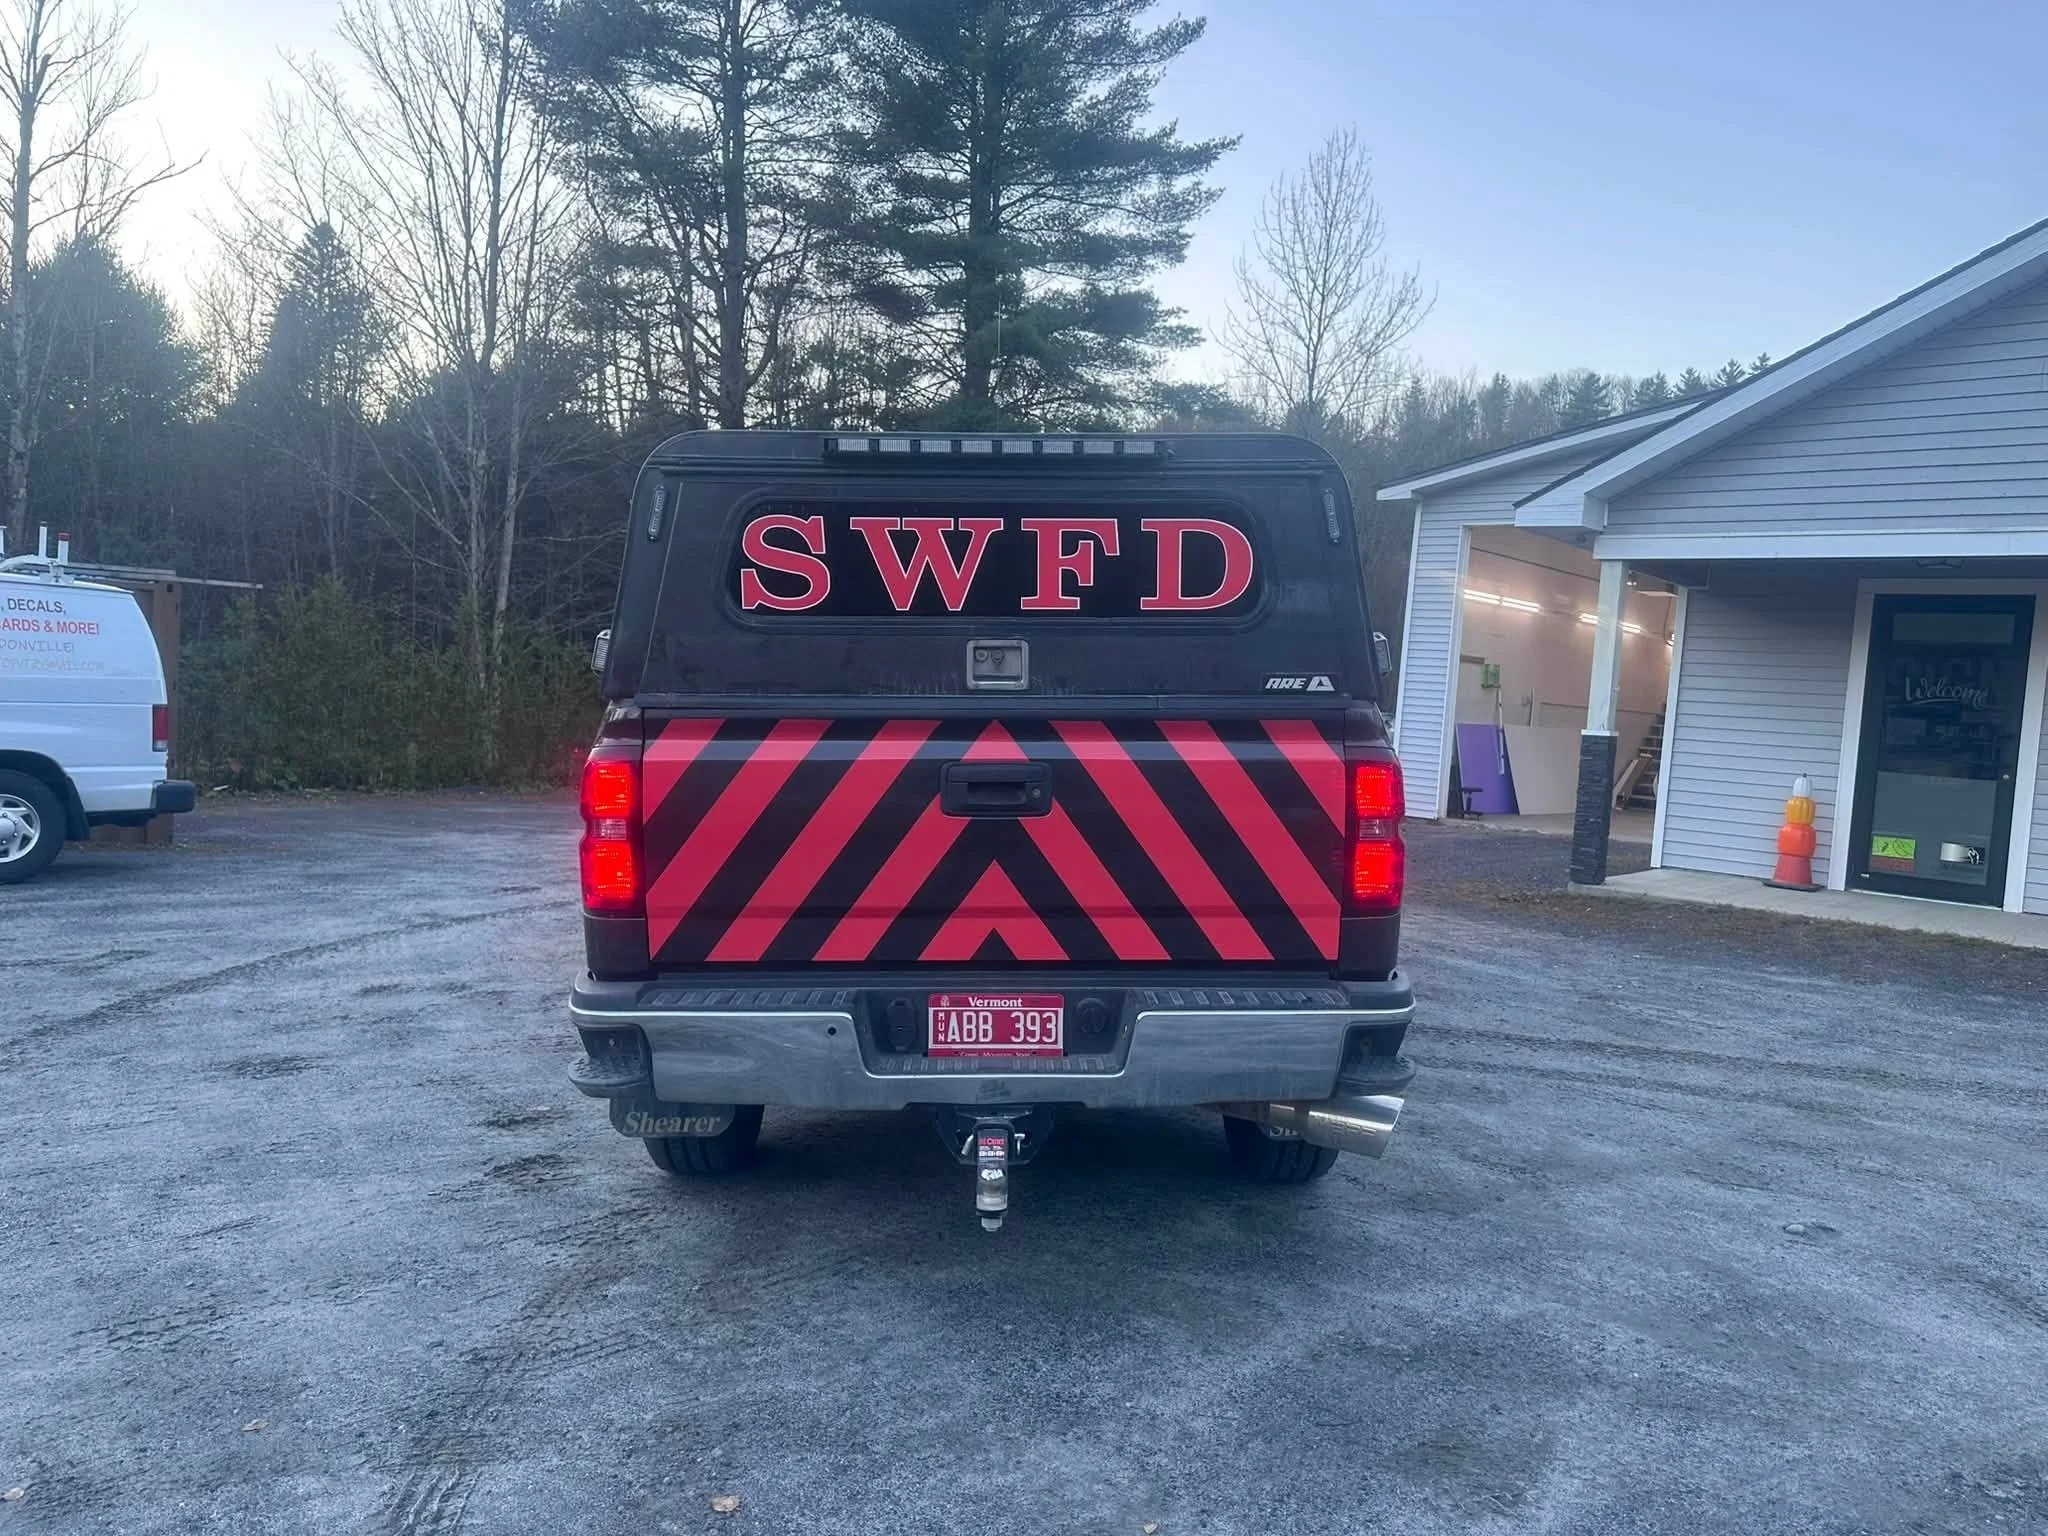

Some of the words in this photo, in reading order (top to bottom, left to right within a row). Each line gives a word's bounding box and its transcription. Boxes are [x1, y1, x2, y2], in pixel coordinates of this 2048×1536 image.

[741, 514, 1253, 610] SWFD
[7, 598, 67, 614] DECALS,
[0, 618, 41, 632] ARDS
[43, 620, 53, 633] &
[57, 621, 100, 635] MORE!
[1904, 675, 1990, 711] Welcome
[968, 997, 1022, 1008] Vermont
[947, 1011, 993, 1043] ABB
[1010, 1011, 1057, 1043] 393
[622, 1111, 721, 1134] Shearer
